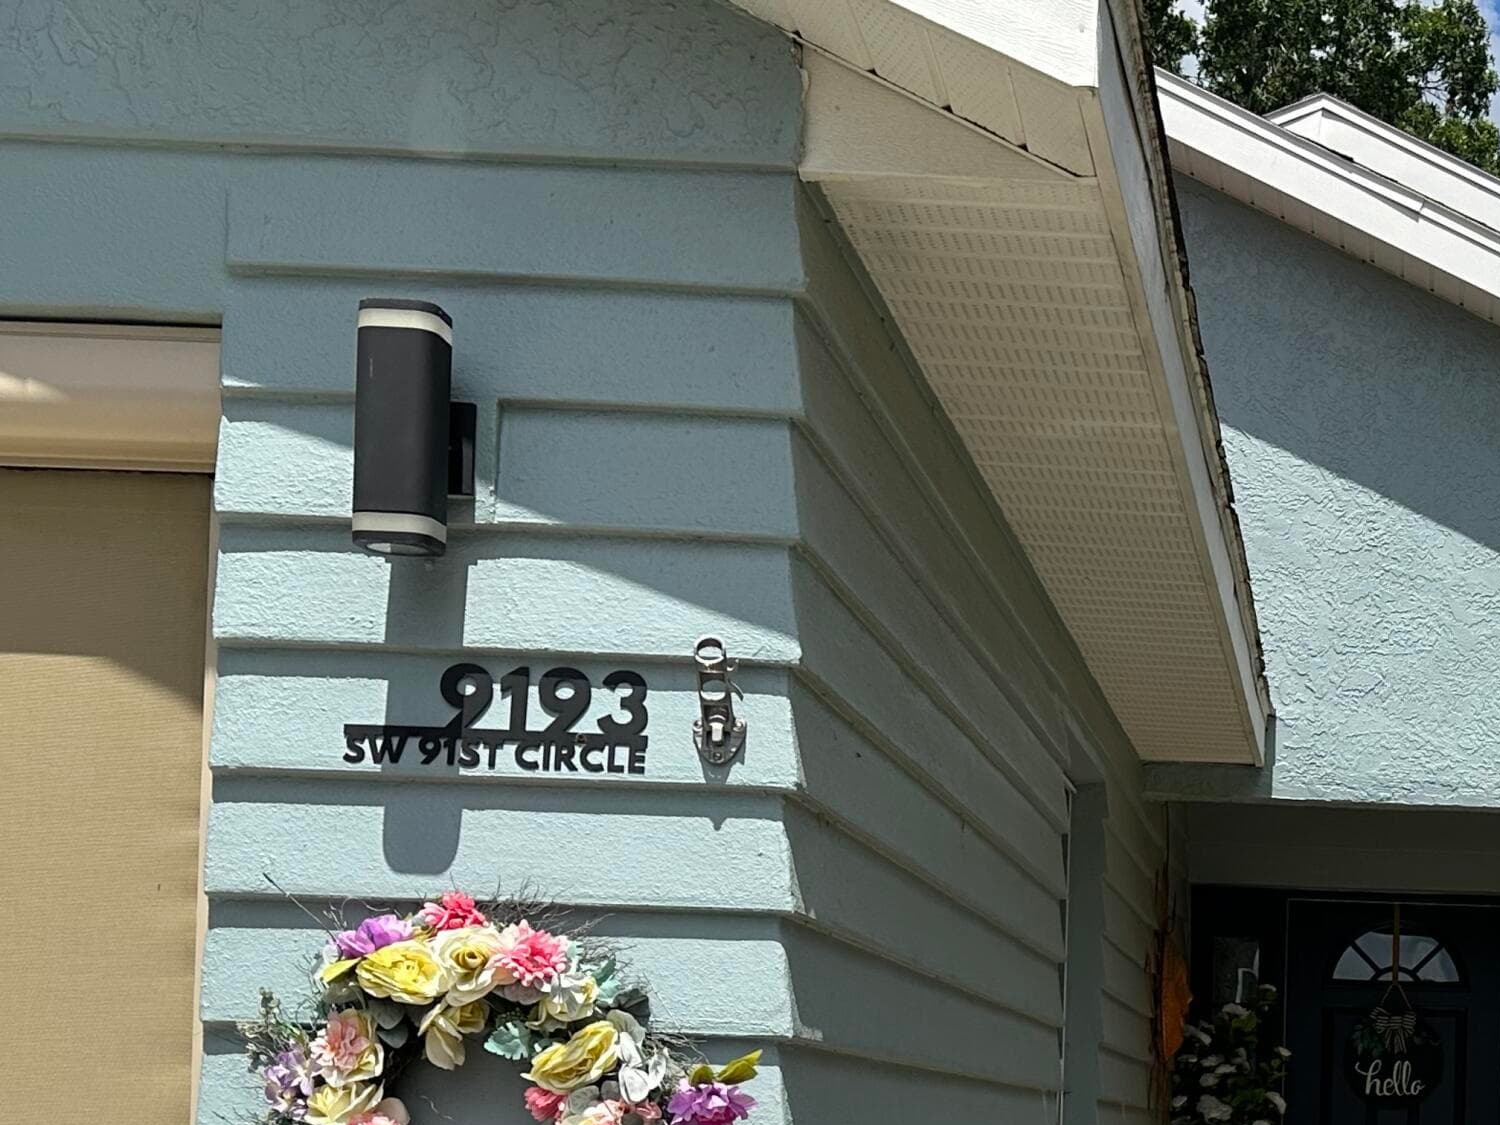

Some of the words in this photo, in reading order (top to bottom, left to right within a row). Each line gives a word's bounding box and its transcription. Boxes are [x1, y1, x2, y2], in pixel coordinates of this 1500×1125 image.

[440, 663, 648, 734] 9193
[343, 733, 407, 765] SW
[418, 734, 504, 771] 91ST
[514, 739, 646, 775] CIRCLE
[1354, 1058, 1426, 1097] hello
